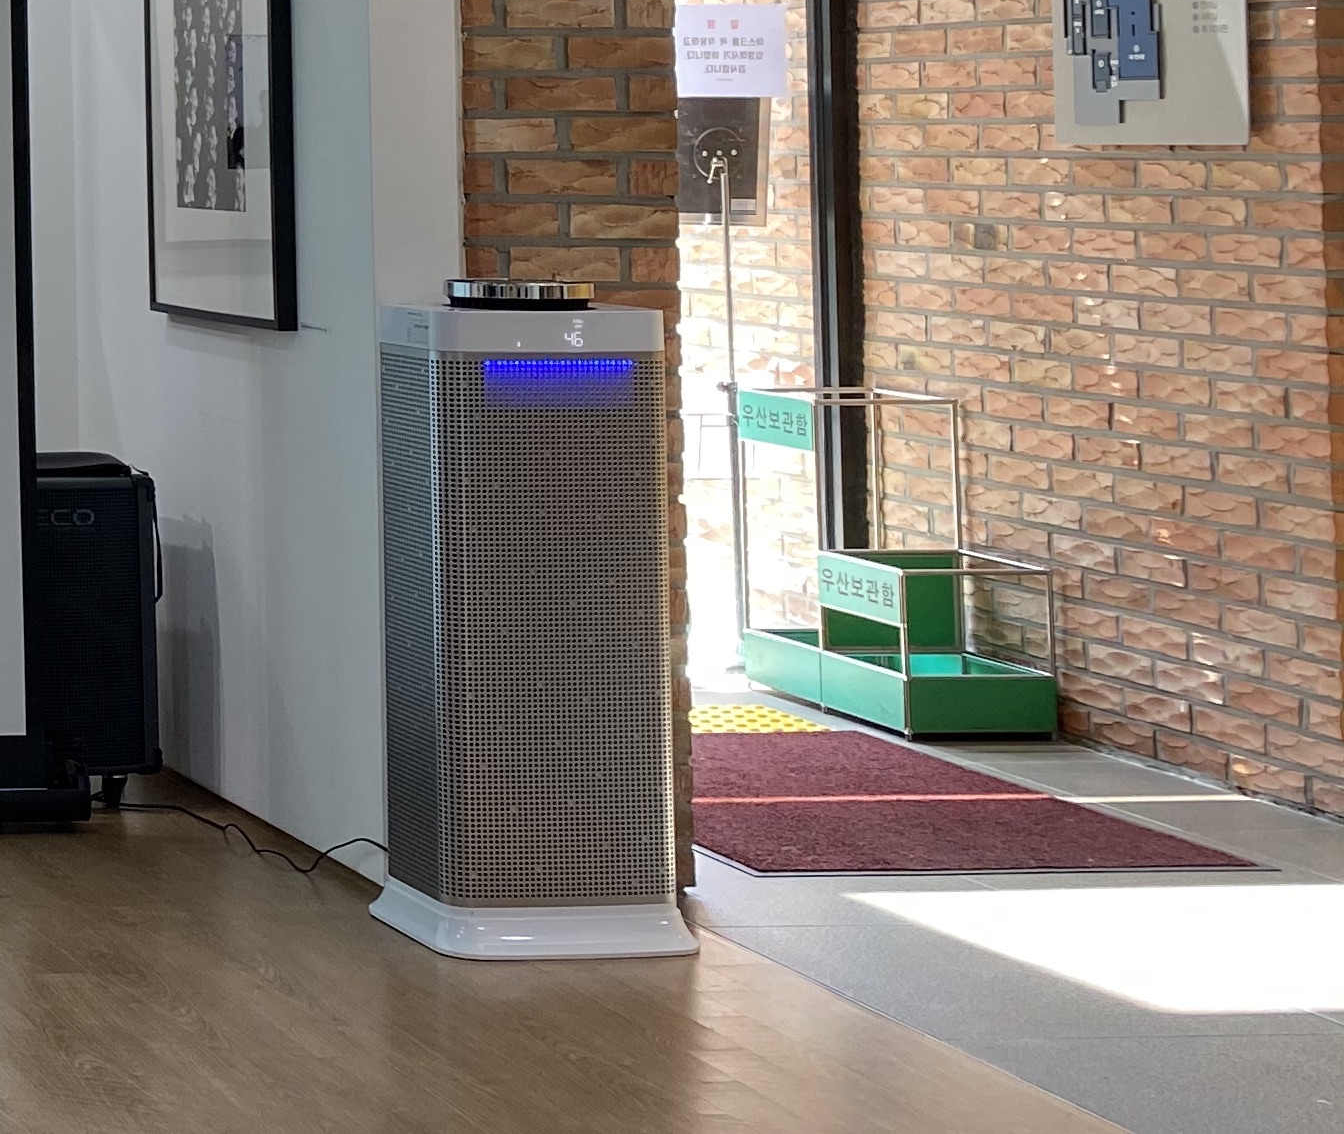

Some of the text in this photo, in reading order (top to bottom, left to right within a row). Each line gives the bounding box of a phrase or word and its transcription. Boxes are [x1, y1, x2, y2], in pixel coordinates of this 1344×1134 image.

[564, 331, 584, 347] 46
[742, 404, 808, 437] 우산보관함
[821, 568, 895, 609] 우산보관함
